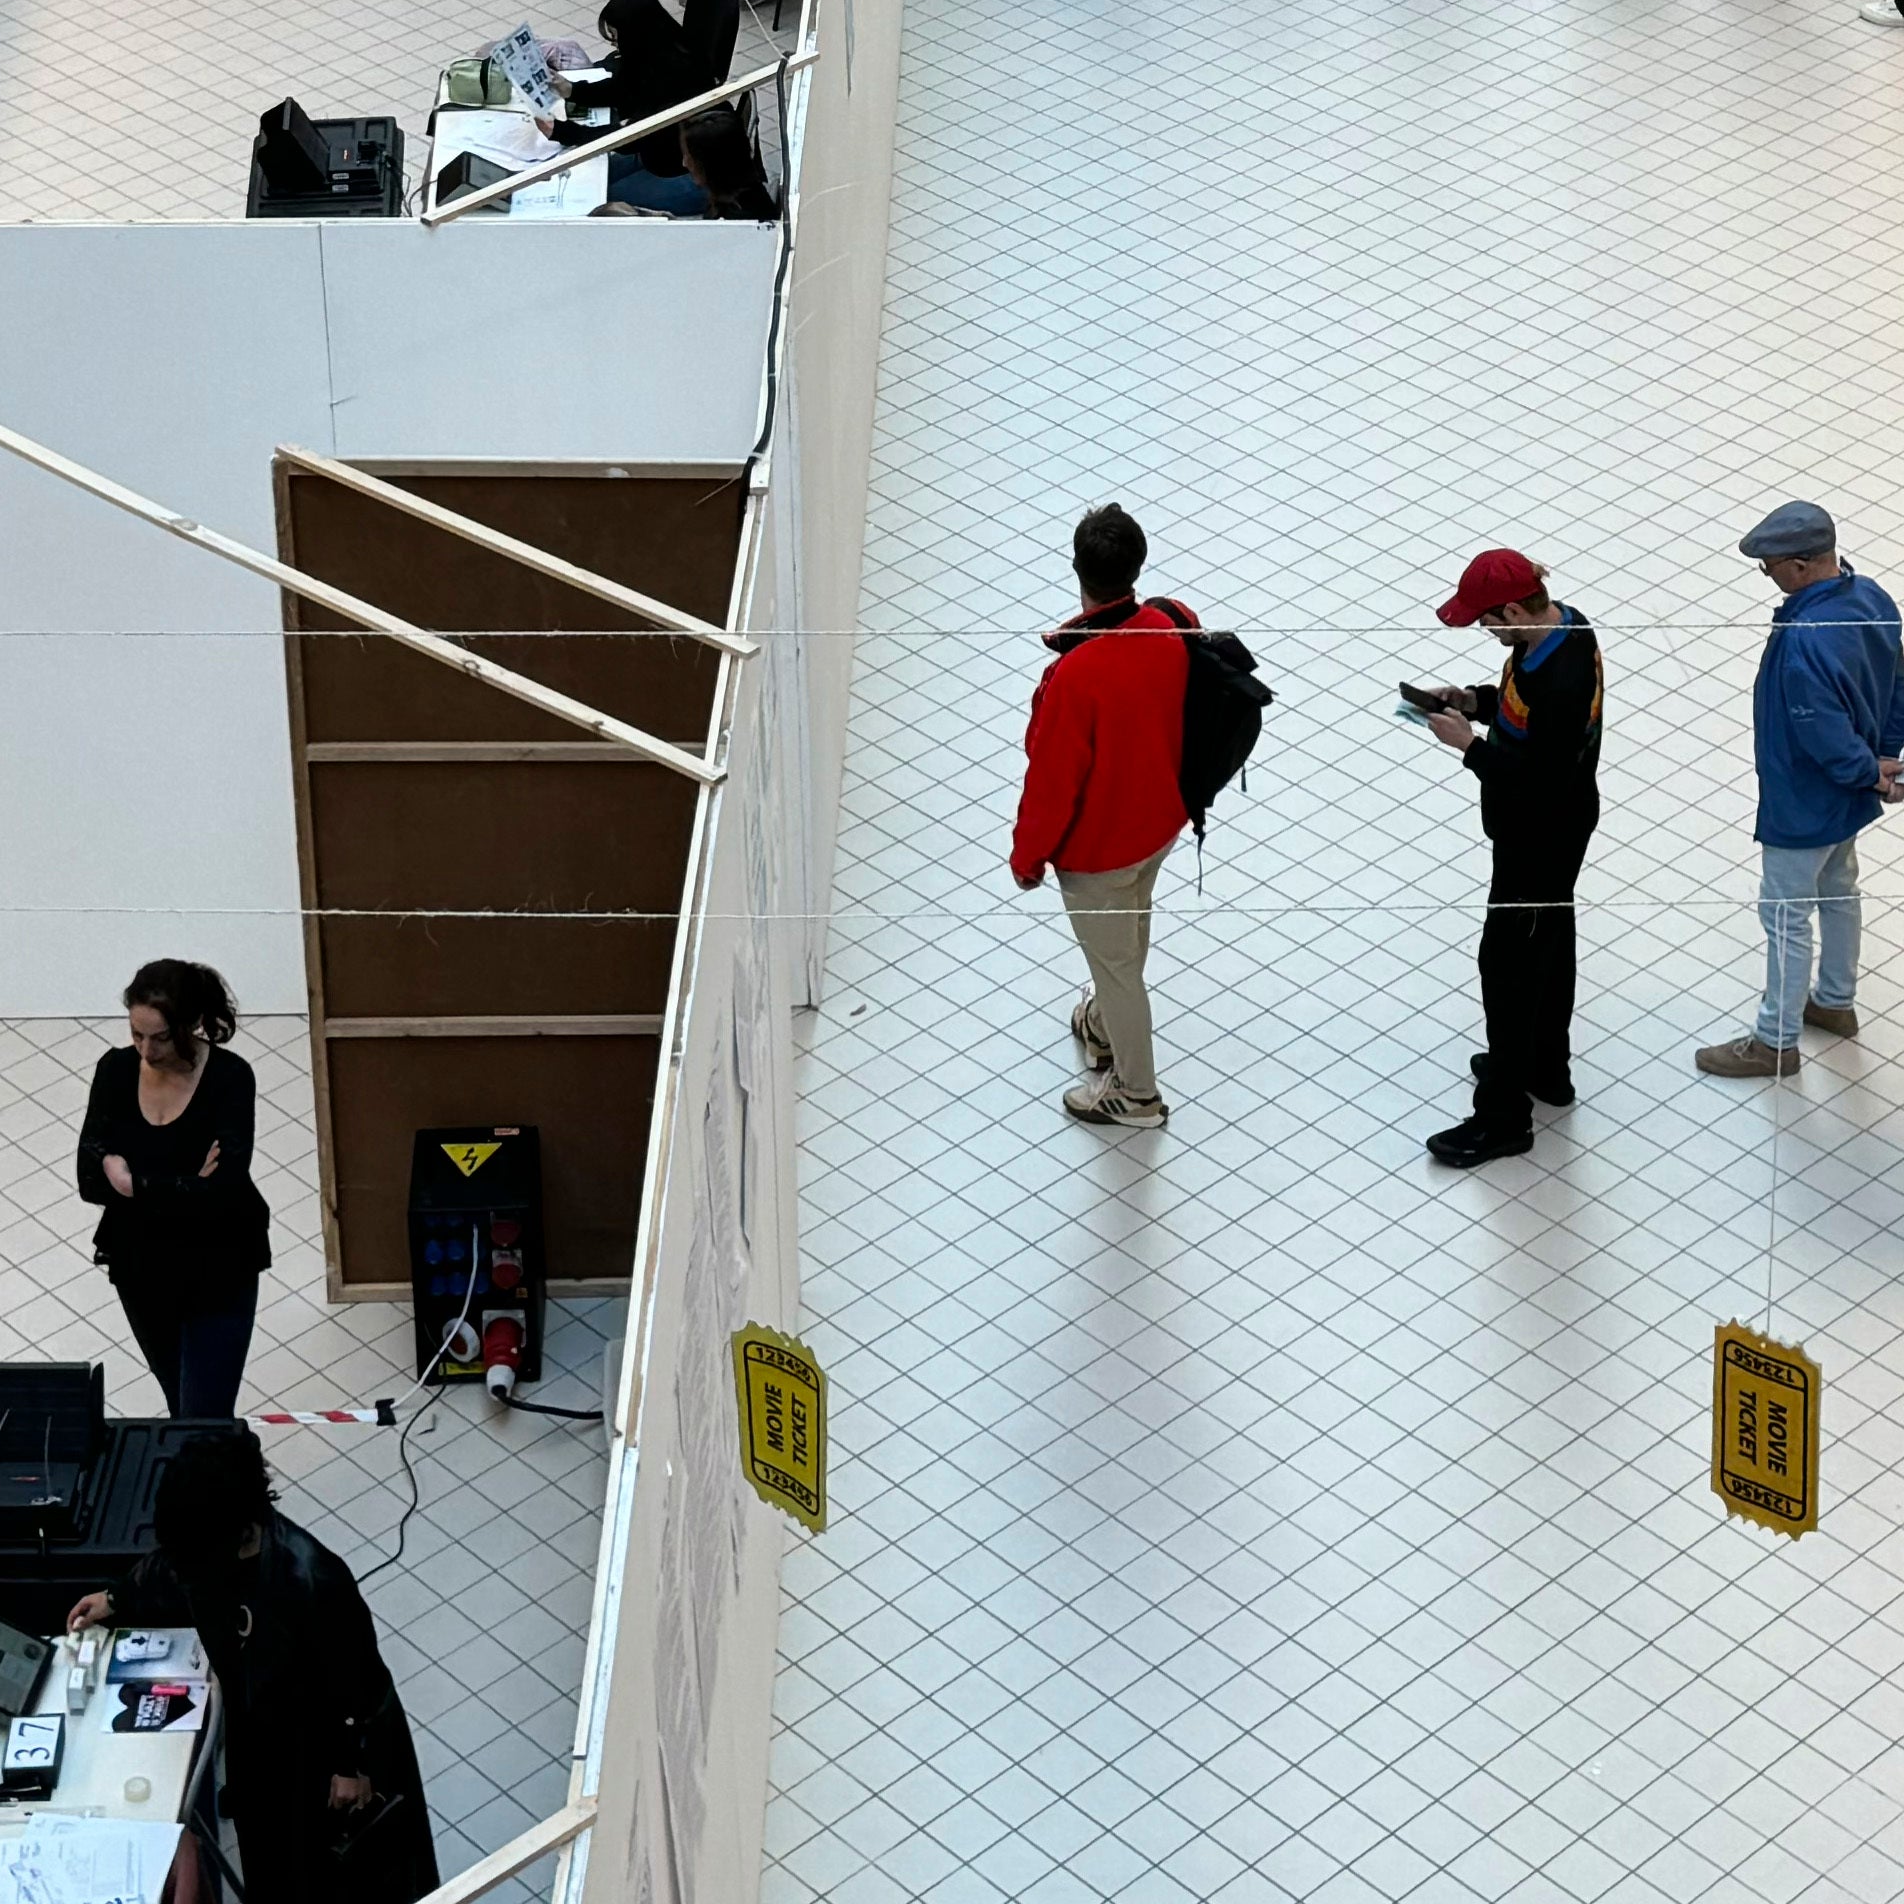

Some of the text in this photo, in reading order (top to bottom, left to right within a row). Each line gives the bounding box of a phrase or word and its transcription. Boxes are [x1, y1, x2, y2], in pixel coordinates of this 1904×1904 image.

[764, 1382, 785, 1453] MOVIE
[791, 1392, 808, 1467] TICKET
[1739, 1389, 1757, 1466] TICKET
[1768, 1400, 1788, 1478] MOVIE
[14, 1721, 54, 1761] 37
